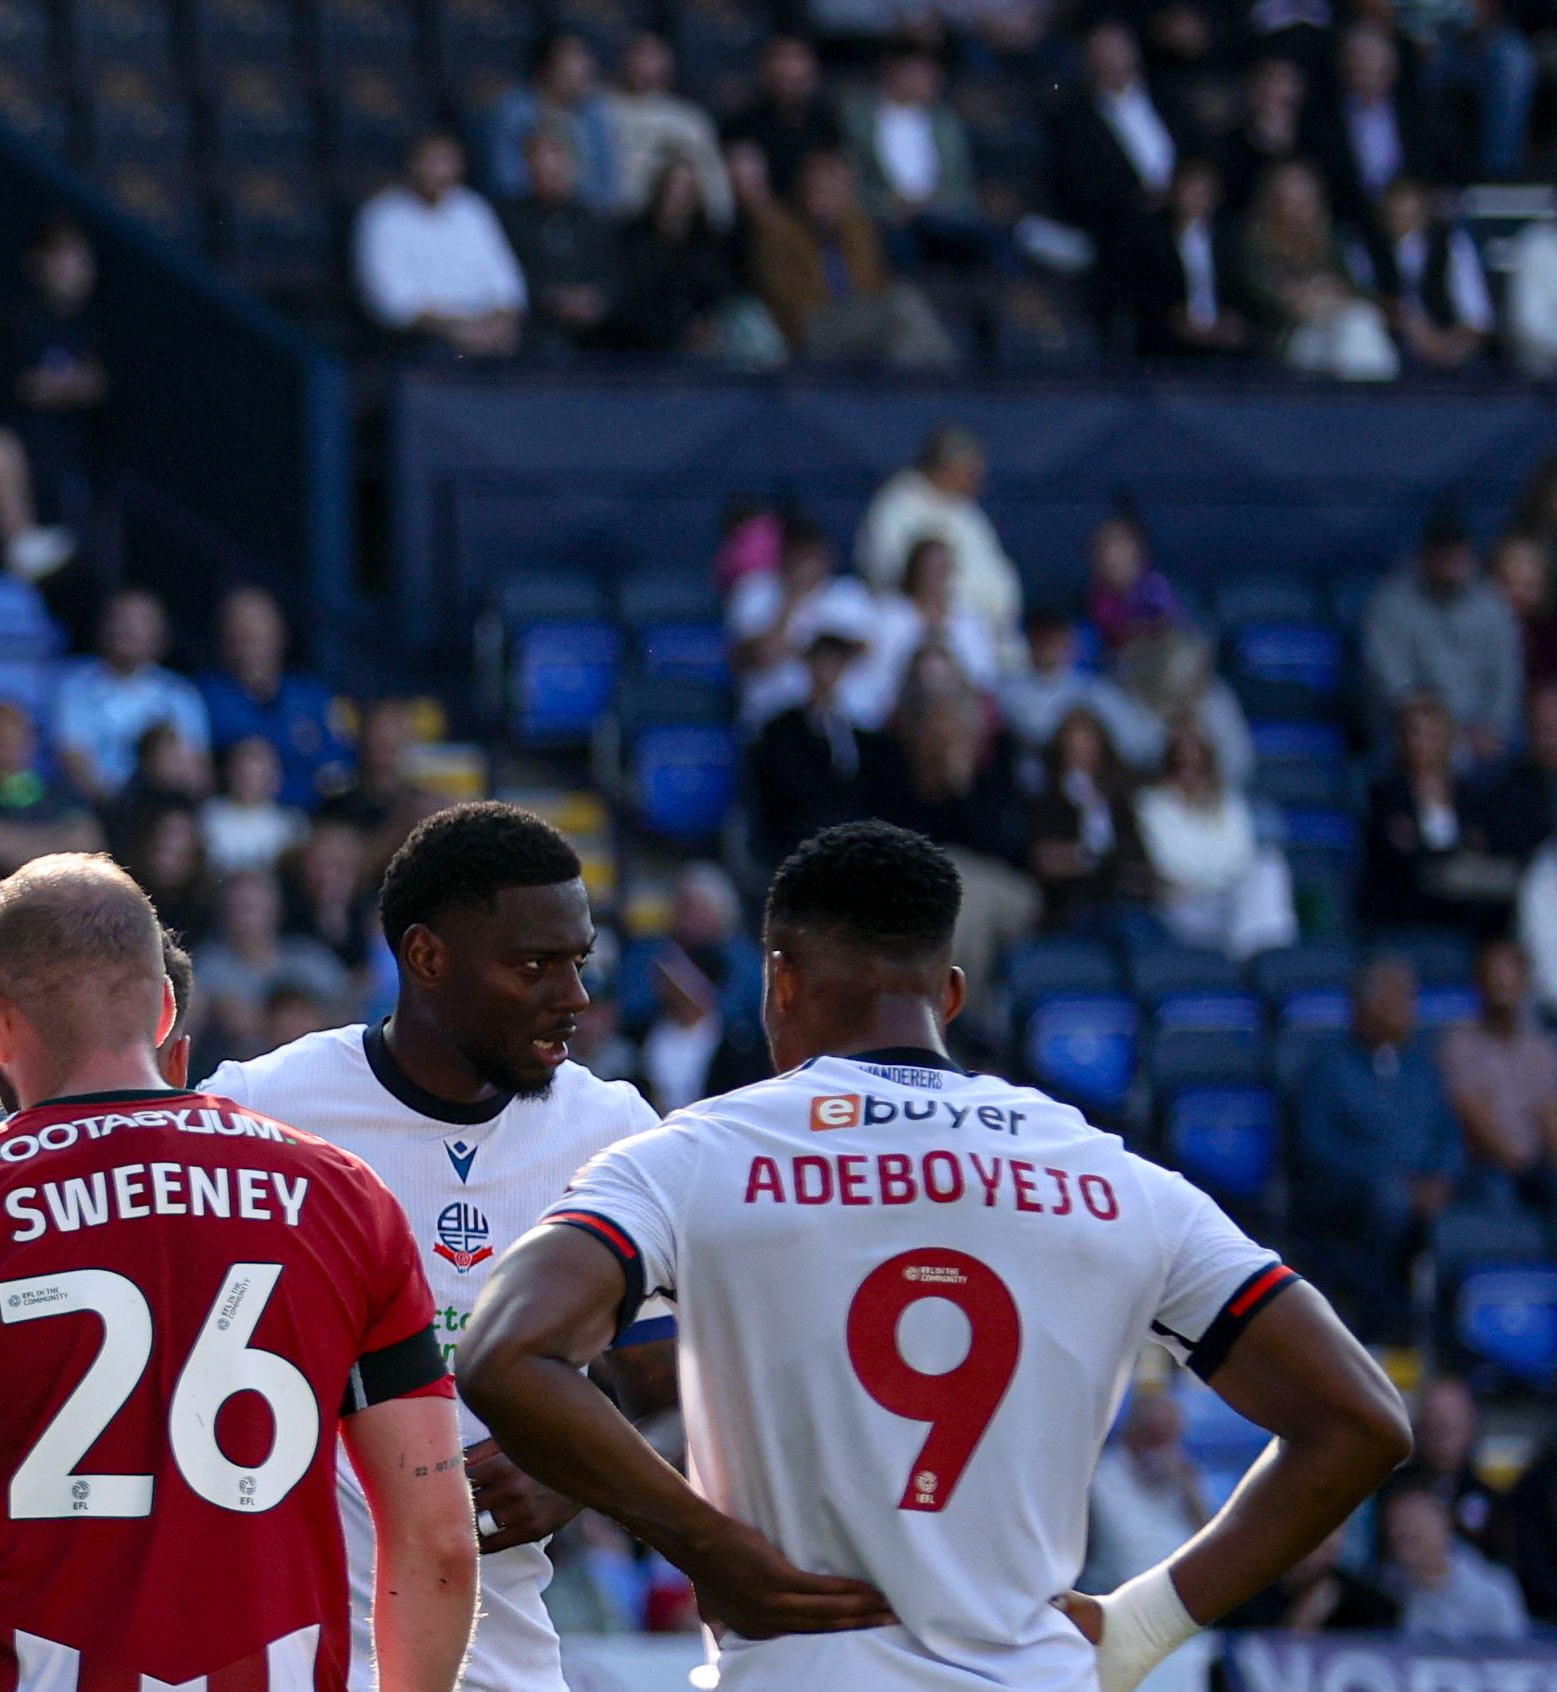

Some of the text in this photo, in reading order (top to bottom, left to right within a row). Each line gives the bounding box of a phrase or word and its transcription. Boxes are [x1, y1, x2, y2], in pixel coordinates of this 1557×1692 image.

[817, 1094, 1027, 1136] ebuyer
[4, 1162, 309, 1243] SWEENEY
[745, 1150, 1119, 1221] ADEBOYEJO
[846, 1247, 1022, 1512] 9
[73, 1501, 89, 1510] EFL
[240, 1496, 255, 1506] EFL
